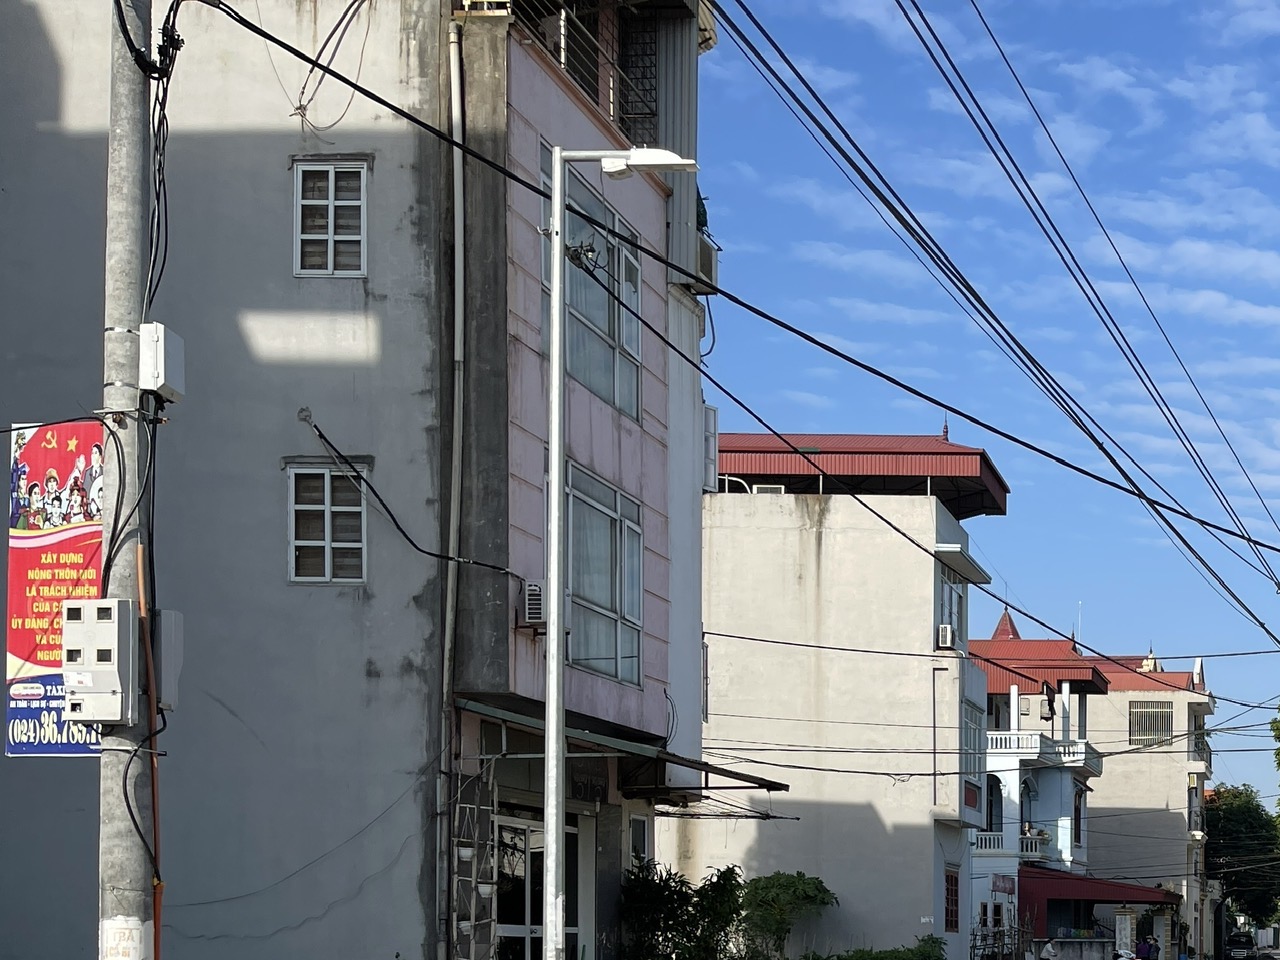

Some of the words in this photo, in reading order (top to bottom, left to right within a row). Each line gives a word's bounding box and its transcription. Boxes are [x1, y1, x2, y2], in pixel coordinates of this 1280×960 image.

[41, 551, 57, 564] XÂY
[59, 552, 84, 566] DỰNG
[27, 567, 52, 580] NÔNG
[54, 567, 77, 580] THÔN
